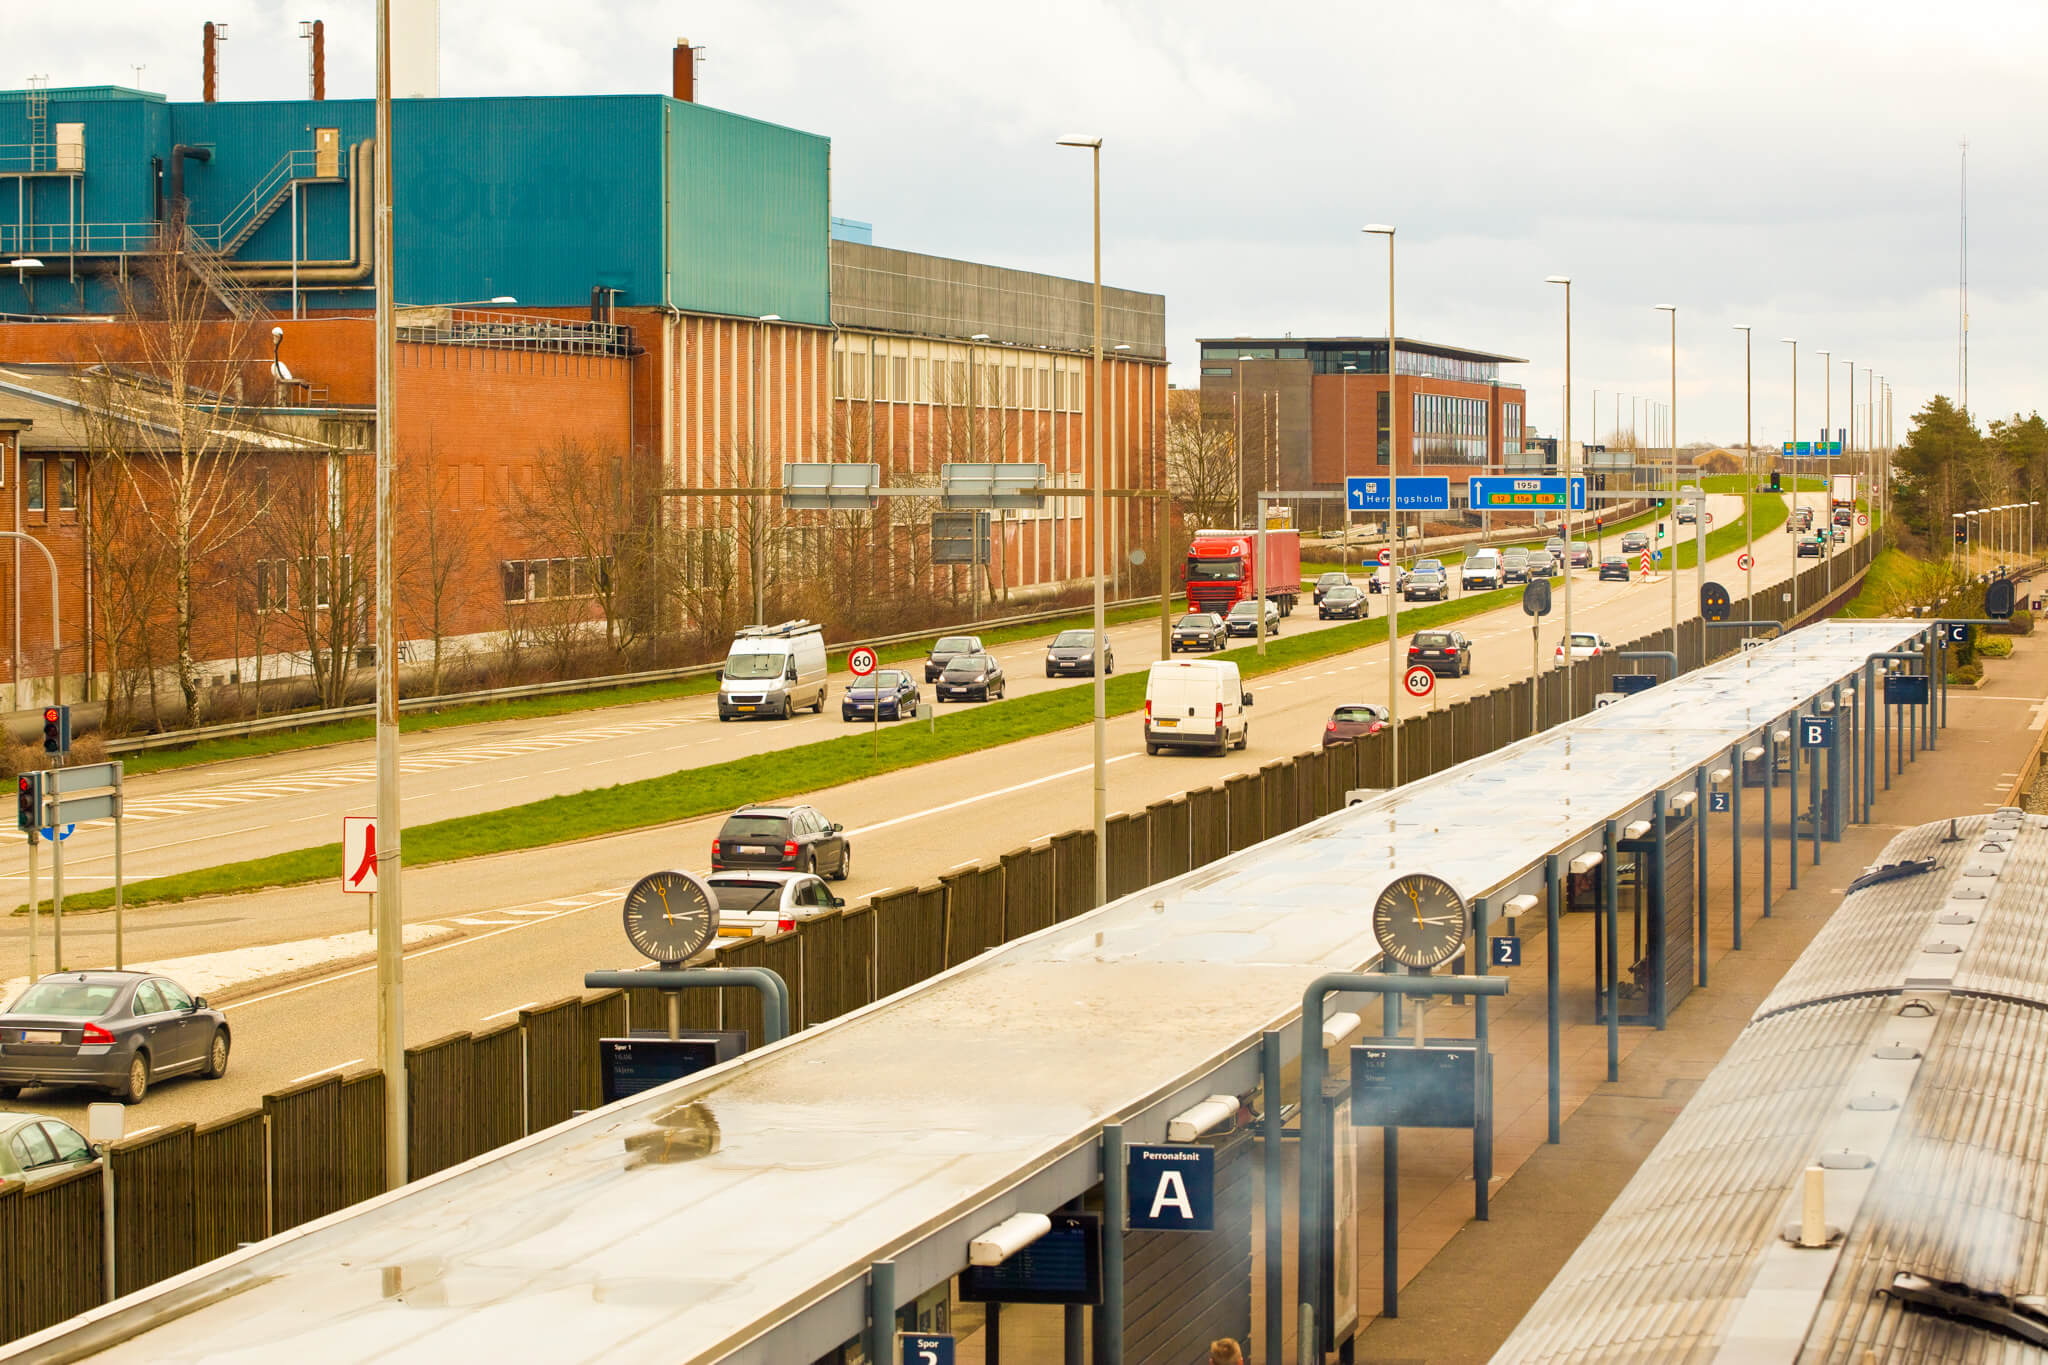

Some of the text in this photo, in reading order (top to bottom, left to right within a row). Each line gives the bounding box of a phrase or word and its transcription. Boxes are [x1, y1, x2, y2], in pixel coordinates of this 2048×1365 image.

[1366, 494, 1442, 504] Hernngsholm
[1953, 628, 1963, 640] C
[853, 656, 871, 667] 60
[1409, 676, 1429, 687] 60
[1808, 726, 1822, 744] B
[1715, 798, 1725, 810] 2
[1500, 946, 1513, 962] 2
[1143, 1151, 1200, 1160] Perronafsnit
[1149, 1170, 1194, 1218] A
[917, 1339, 939, 1349] Spor
